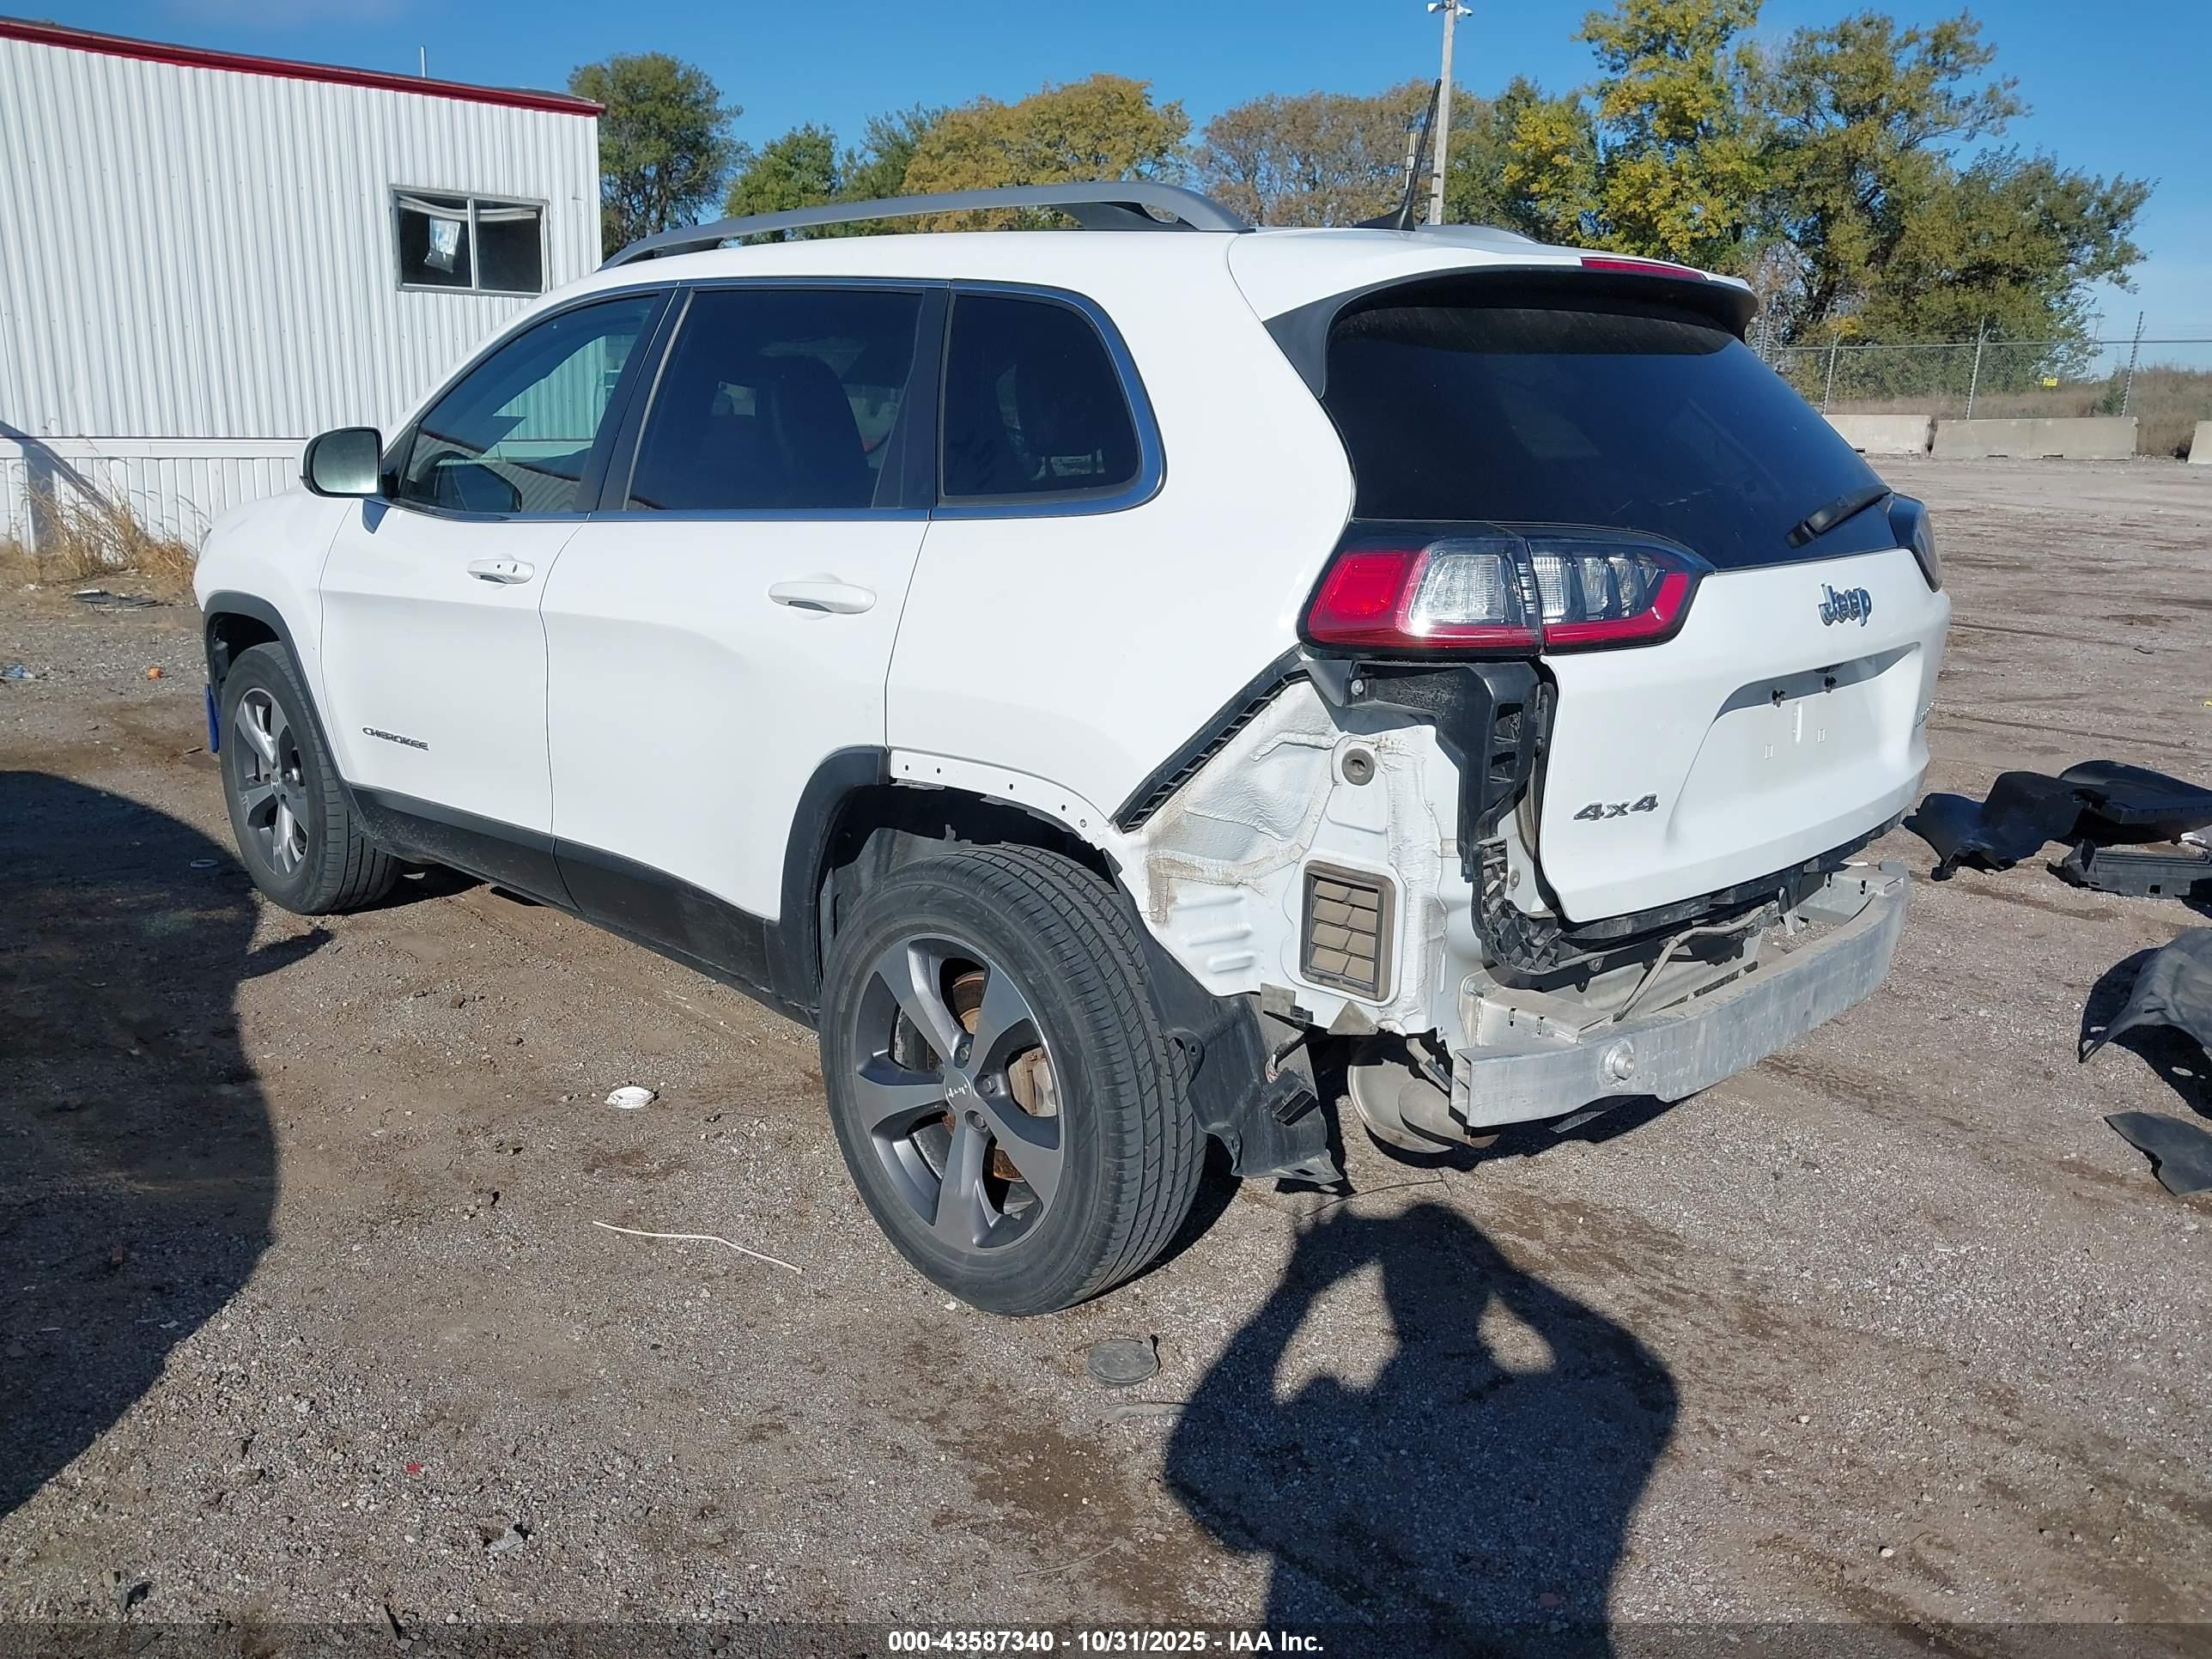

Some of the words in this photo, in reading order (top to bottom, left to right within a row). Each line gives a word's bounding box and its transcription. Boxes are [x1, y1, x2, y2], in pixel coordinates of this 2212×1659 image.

[1818, 583, 1872, 627] Jeep
[362, 727, 429, 750] CHEROKEE
[1573, 793, 1659, 821] 4x4
